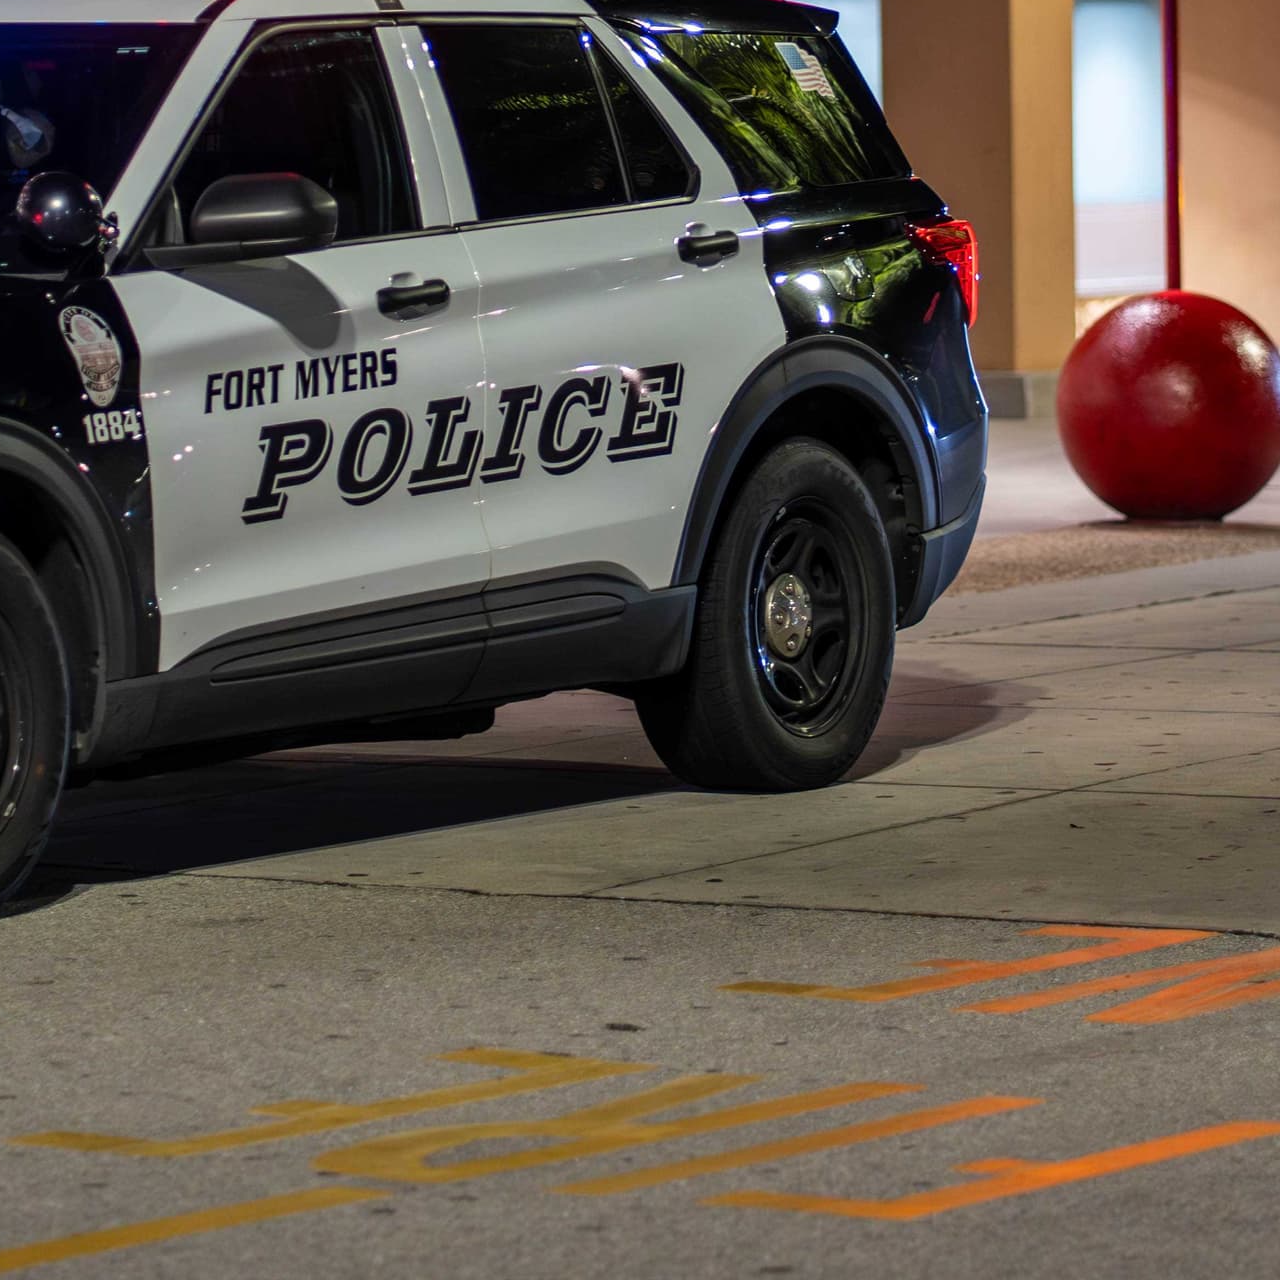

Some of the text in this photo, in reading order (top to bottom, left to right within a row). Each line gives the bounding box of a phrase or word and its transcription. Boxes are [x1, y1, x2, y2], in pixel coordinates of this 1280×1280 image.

[204, 347, 398, 414] FORT MYERS
[83, 409, 142, 445] 1884
[241, 361, 685, 525] POLICE
